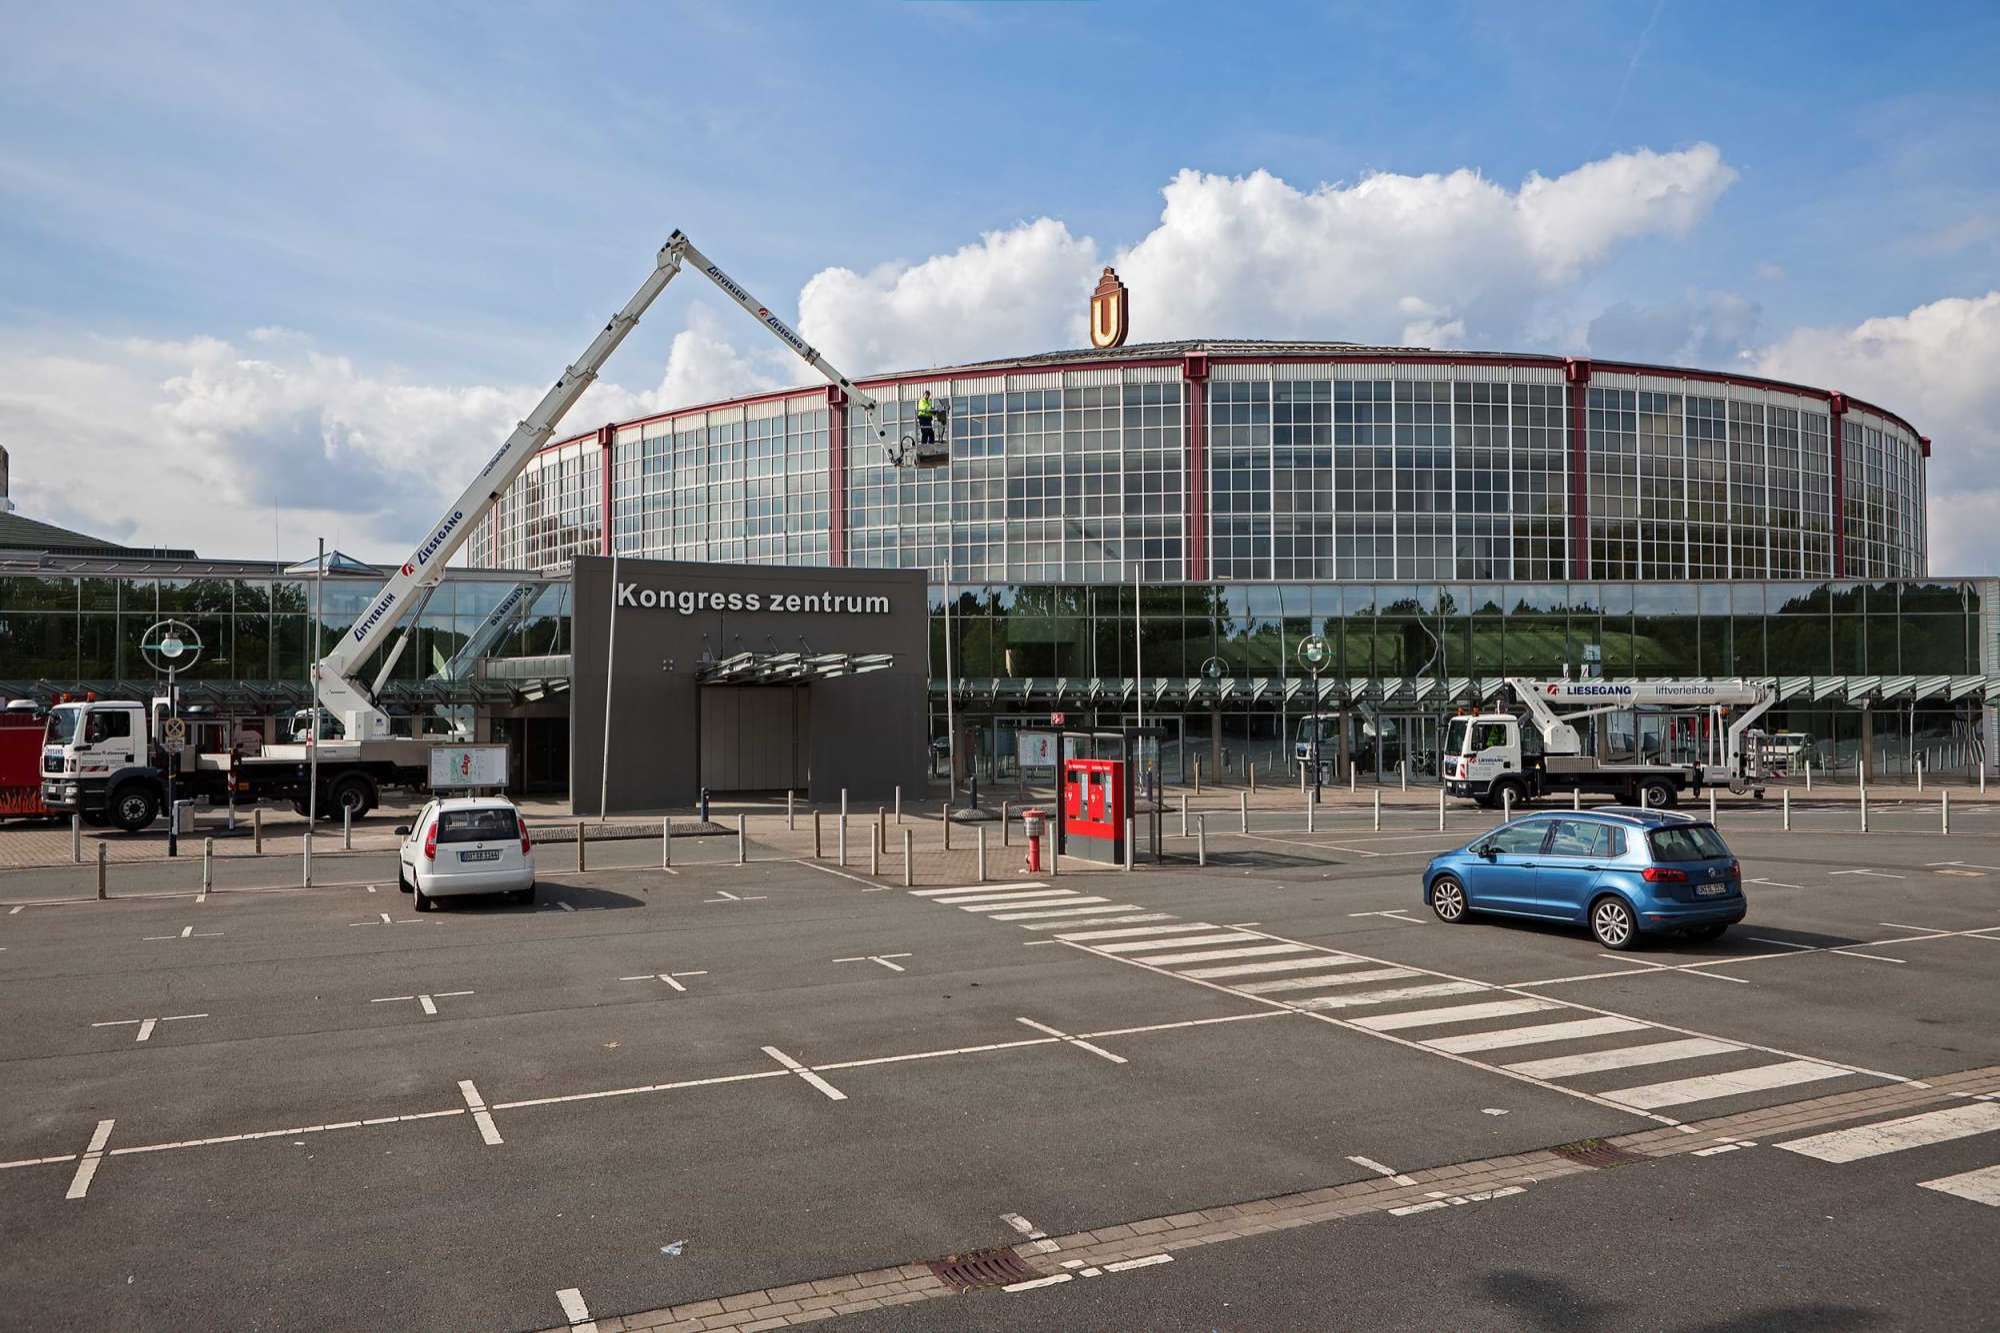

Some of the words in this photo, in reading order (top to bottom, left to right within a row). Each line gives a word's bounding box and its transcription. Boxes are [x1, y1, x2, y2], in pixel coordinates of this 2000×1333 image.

[707, 265, 748, 302] LIFTVERLEIH
[767, 317, 803, 349] LIESEGANG
[1092, 293, 1119, 347] U
[353, 592, 396, 643] LIFTVERLEIH
[417, 510, 464, 566] LIESEGANG
[618, 582, 761, 616] Kongress
[769, 590, 890, 614] zentrum
[1567, 685, 1632, 696] LIESEGANG
[1655, 685, 1715, 695] liftverleih.de
